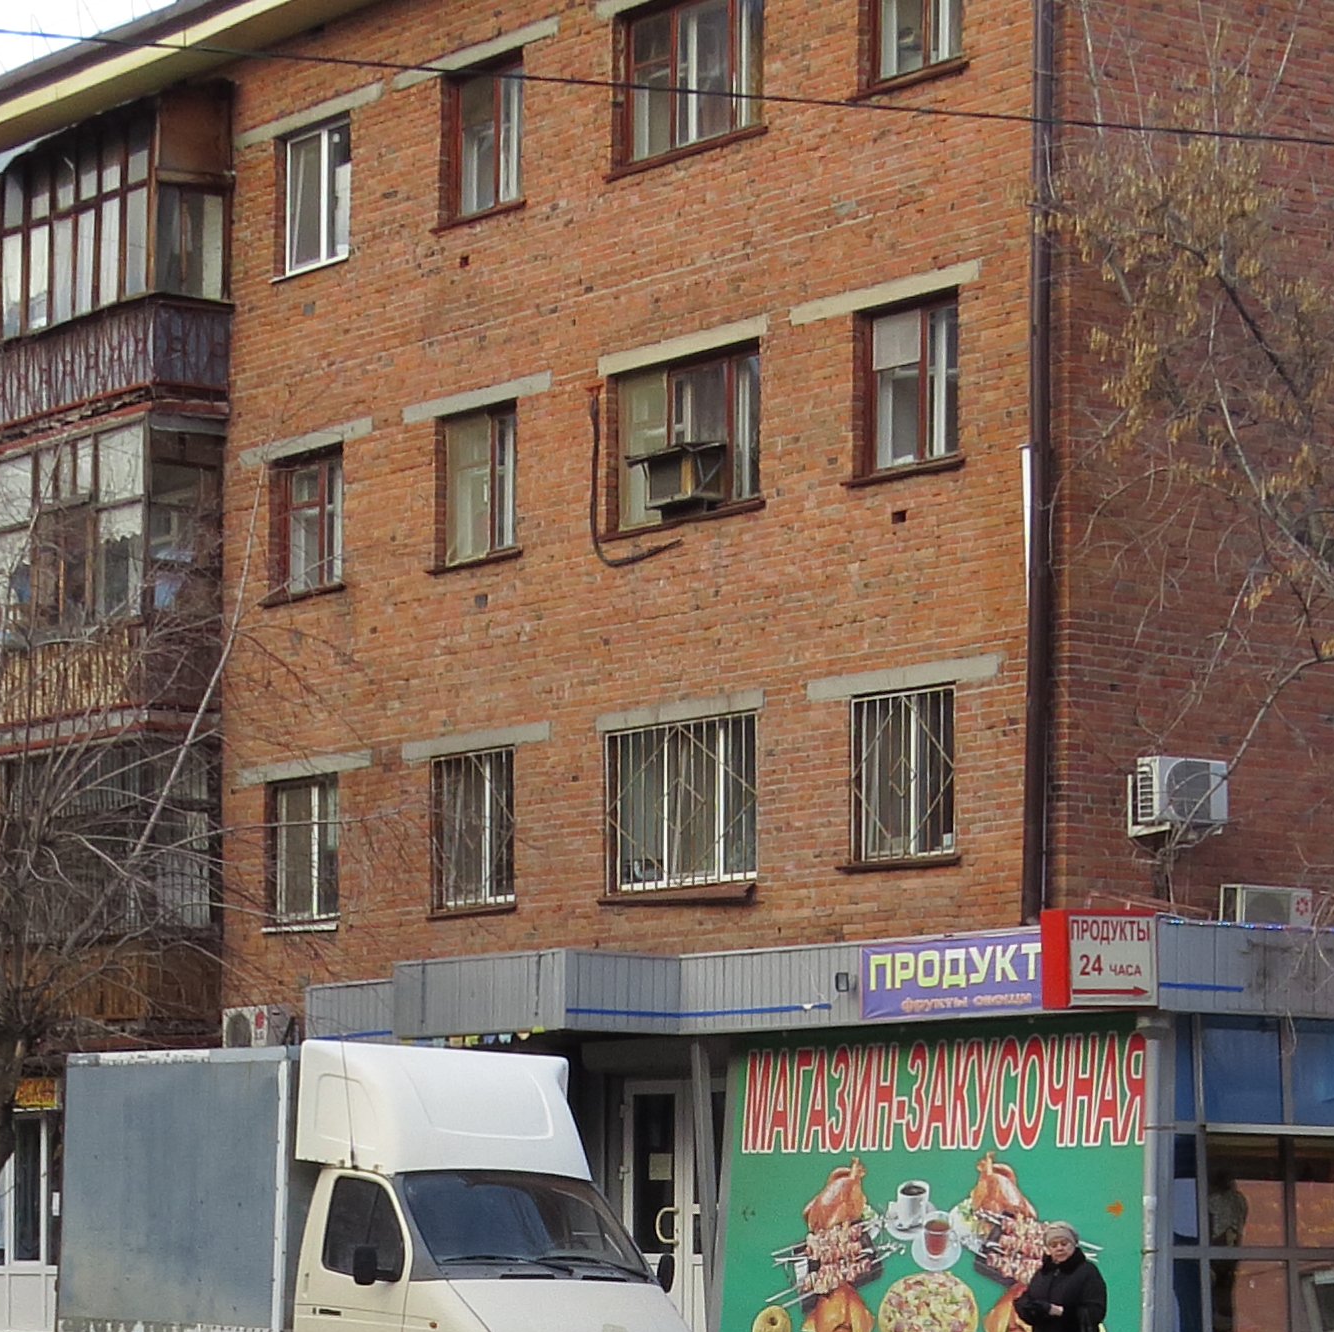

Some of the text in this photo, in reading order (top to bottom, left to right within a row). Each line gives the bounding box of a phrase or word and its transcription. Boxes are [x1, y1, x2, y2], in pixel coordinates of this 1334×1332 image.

[1071, 919, 1150, 945] ПРОДУКТЫ
[869, 942, 1042, 992] ПРОДУКТ
[1079, 953, 1142, 976] 24 ЧАСА
[742, 1031, 1146, 1154] МАГАЗИН-ЗАКУСОЧНАЯ
